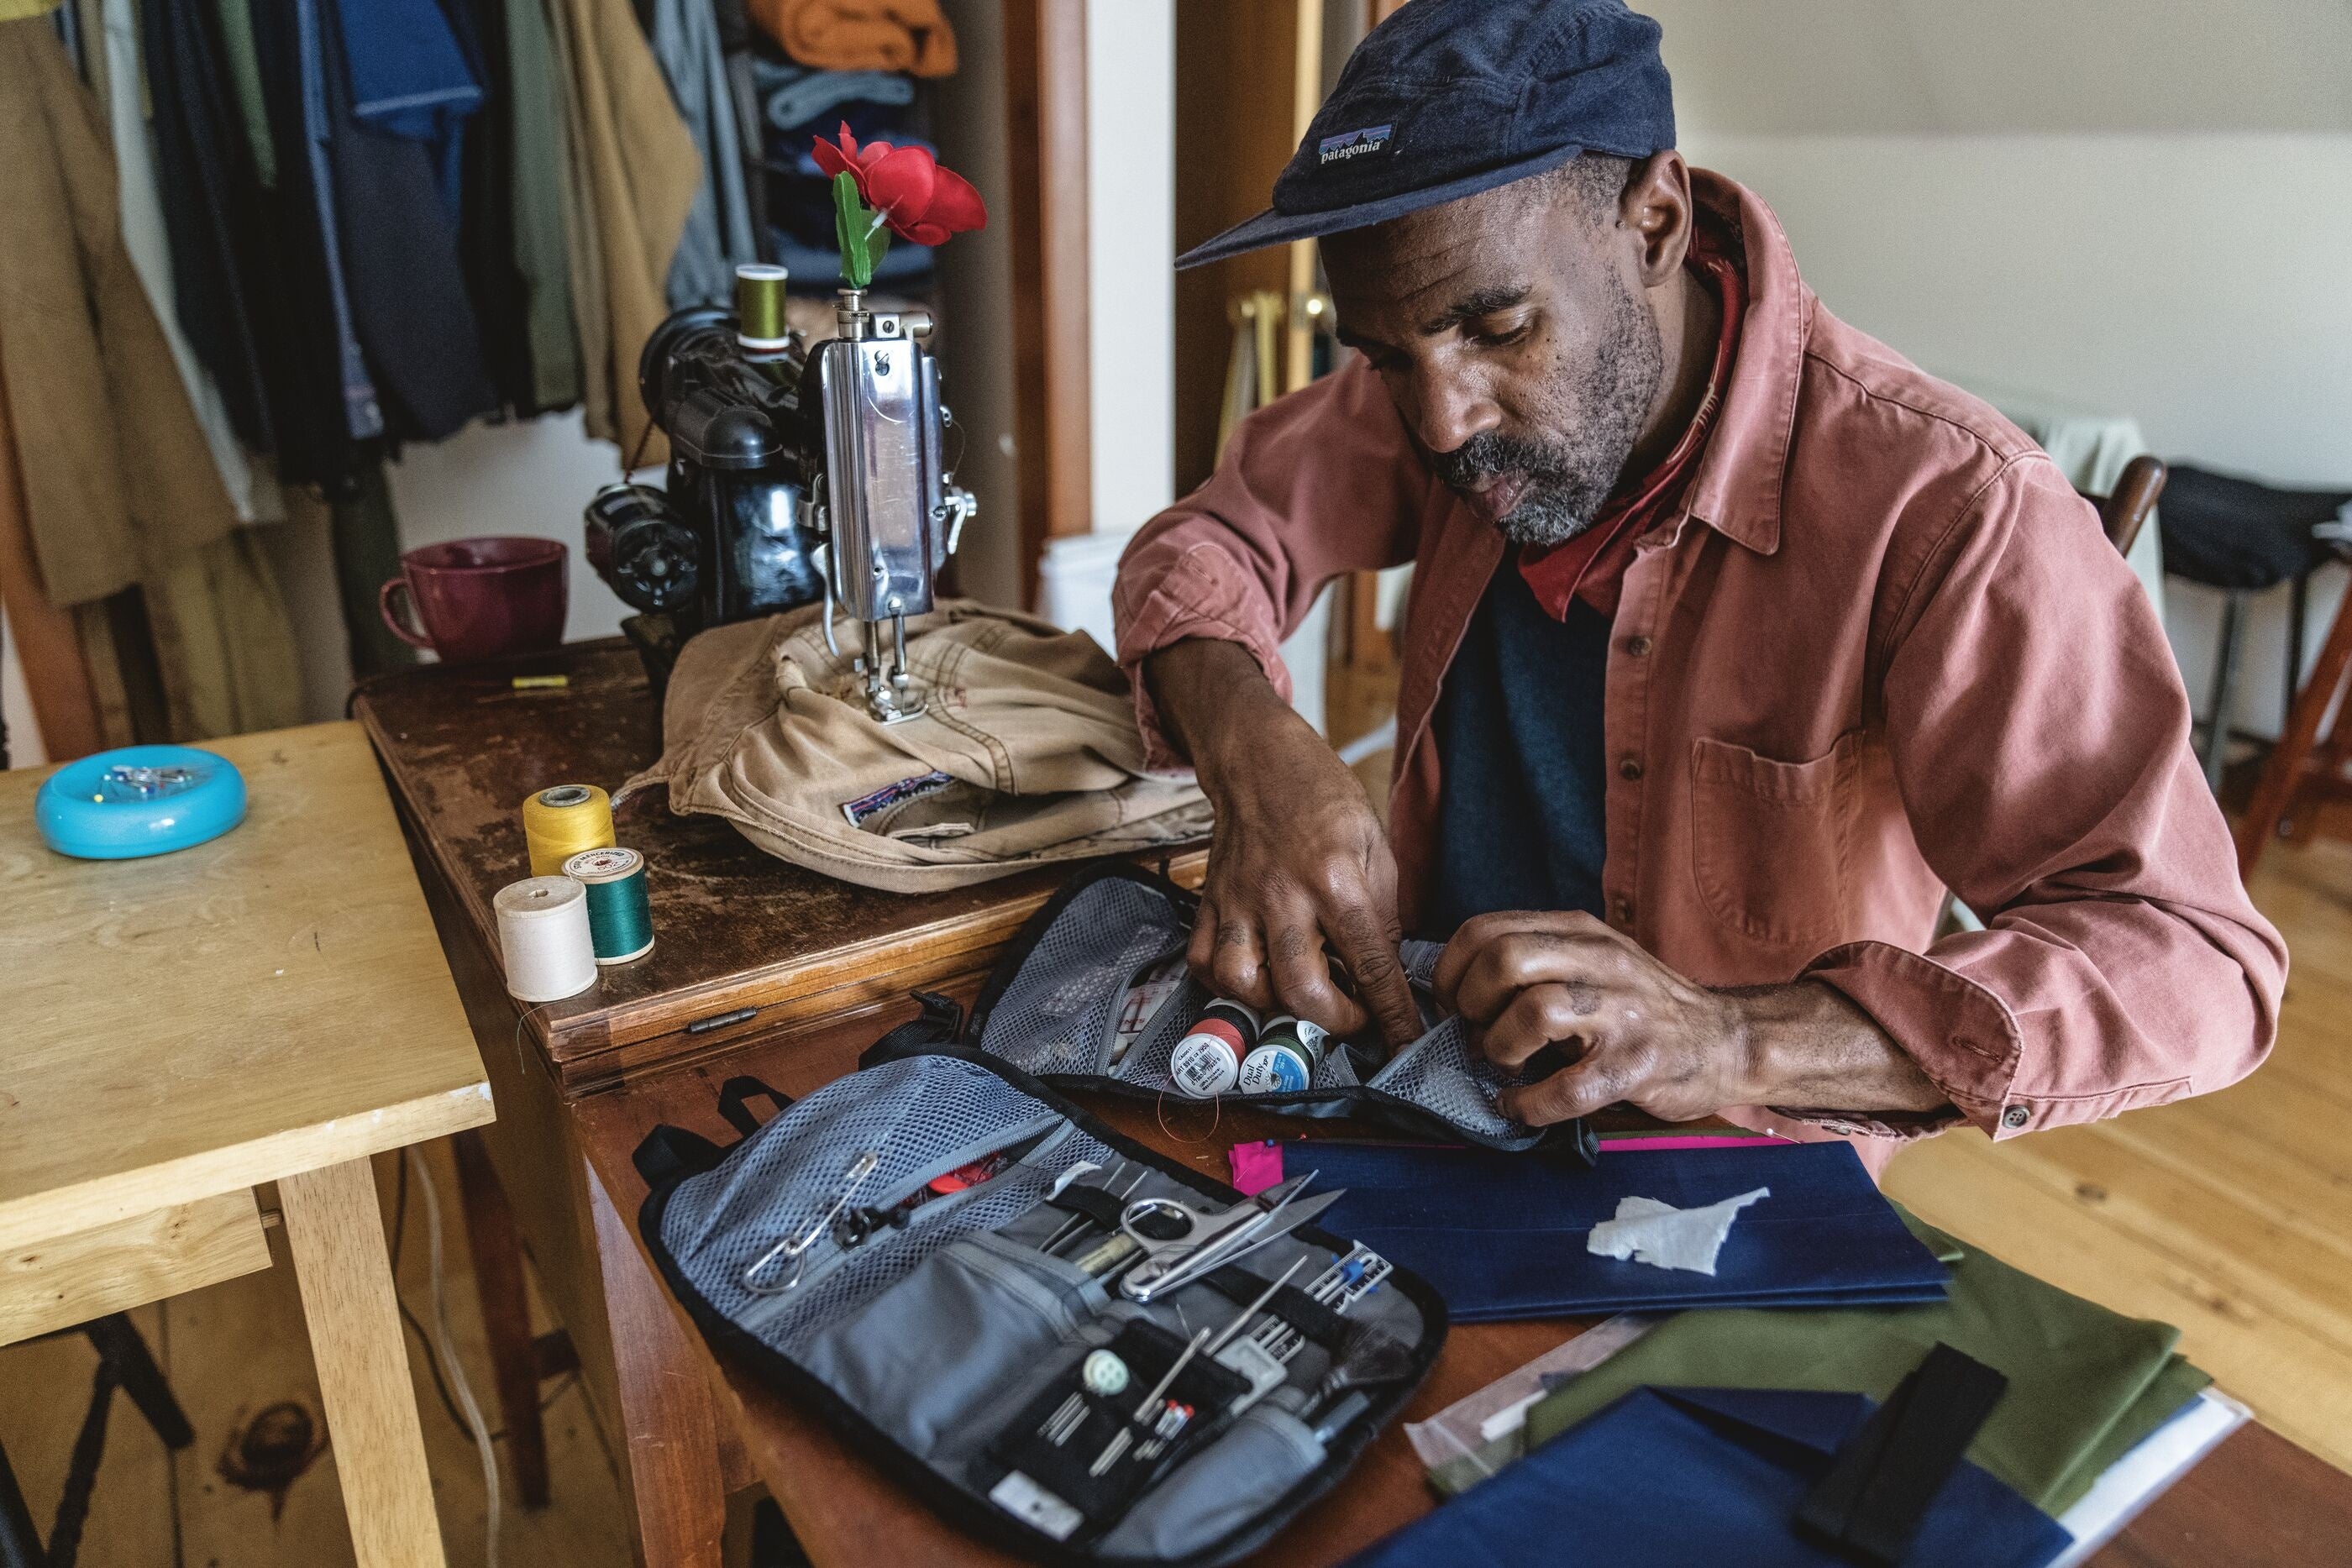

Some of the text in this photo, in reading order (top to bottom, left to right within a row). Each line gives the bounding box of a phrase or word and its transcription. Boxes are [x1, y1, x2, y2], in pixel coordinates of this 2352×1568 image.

[1320, 140, 1381, 165] patagonia
[1243, 1064, 1255, 1086] Dual
[1252, 1062, 1266, 1085] Duty
